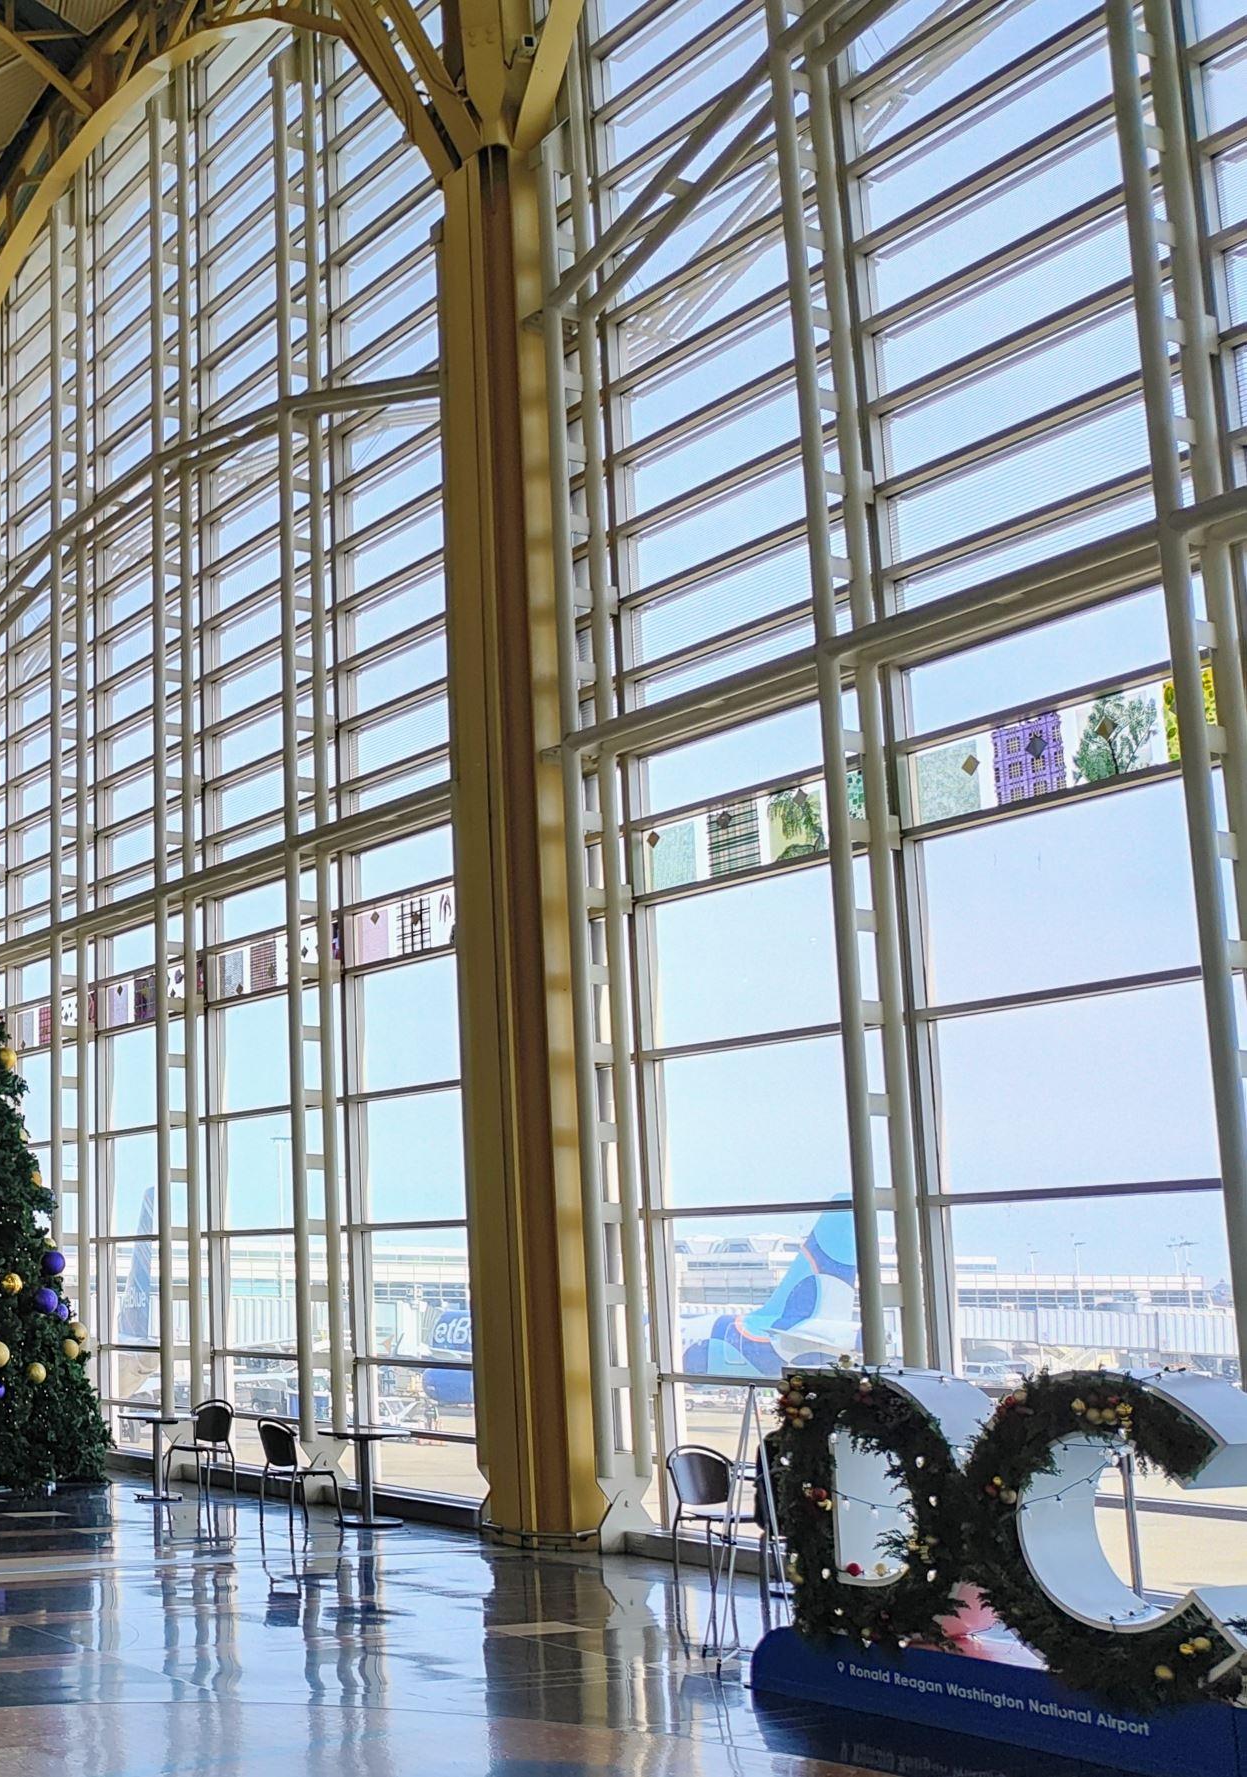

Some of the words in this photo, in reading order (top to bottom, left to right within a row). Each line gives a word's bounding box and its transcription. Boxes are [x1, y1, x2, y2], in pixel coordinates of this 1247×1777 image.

[849, 1663, 891, 1684] Ronald
[894, 1672, 943, 1694] Reagan
[946, 1682, 1024, 1711] Washington
[1028, 1699, 1092, 1725] National
[1096, 1713, 1150, 1737] Airport
